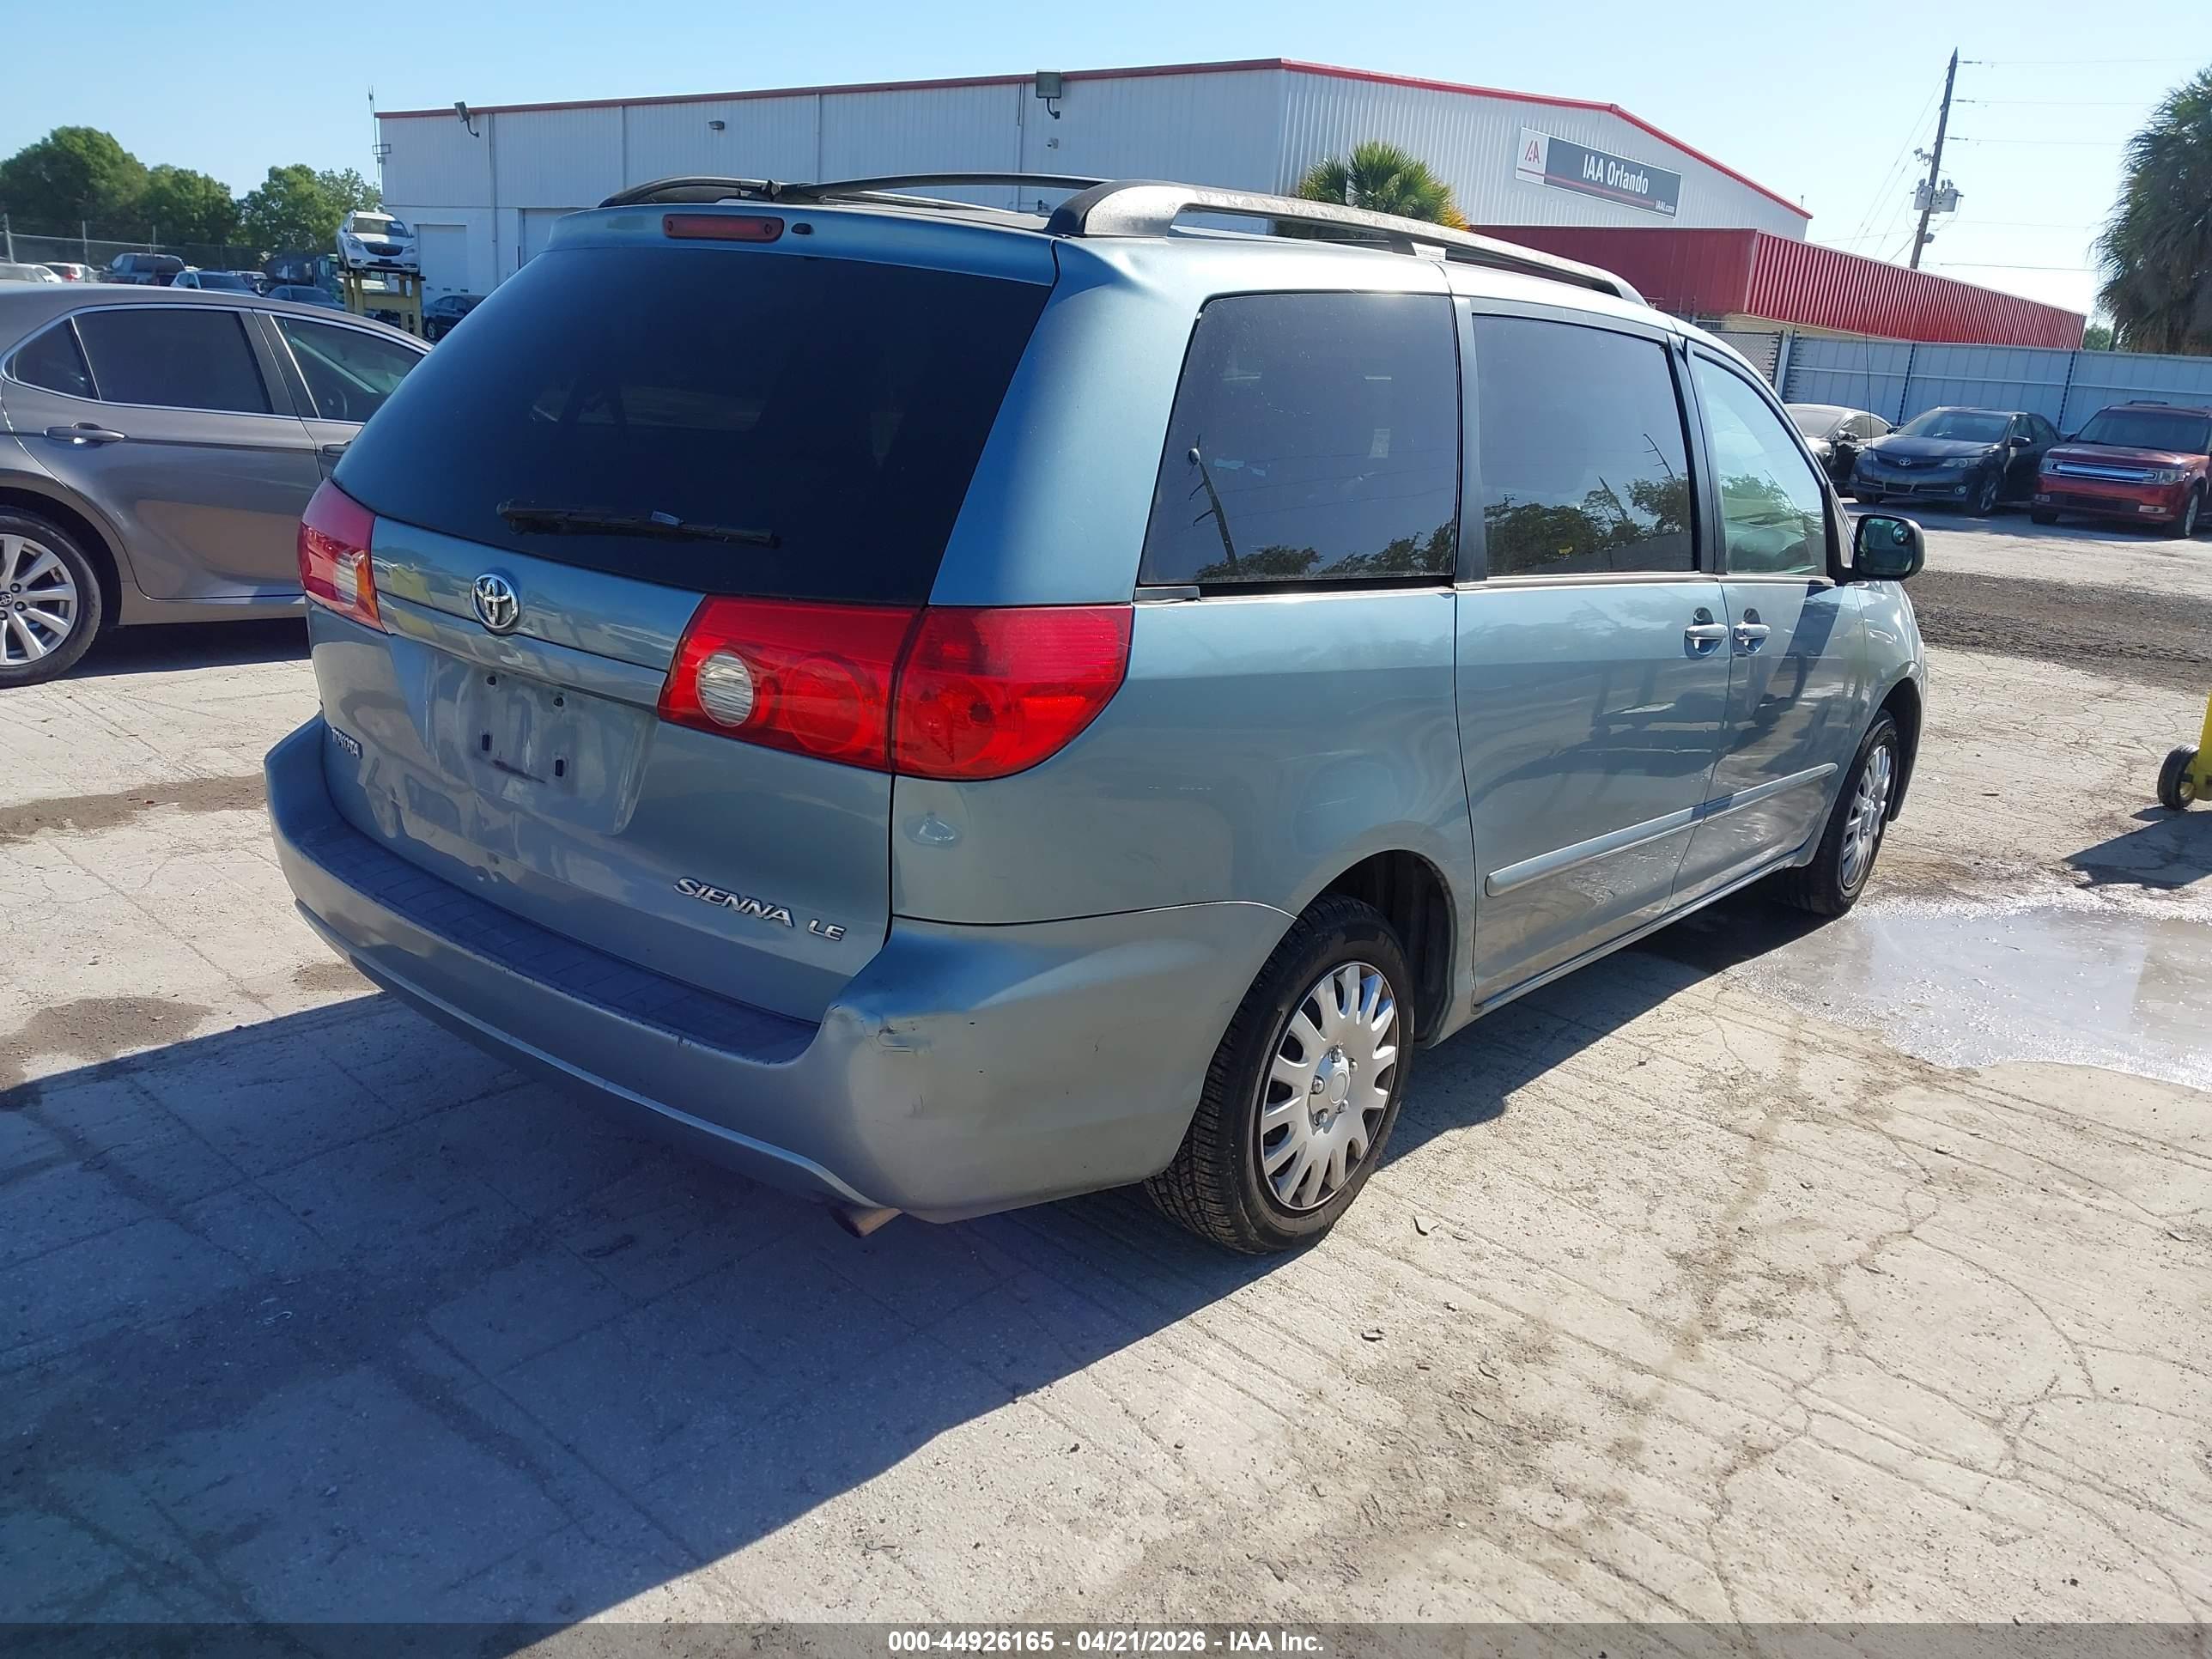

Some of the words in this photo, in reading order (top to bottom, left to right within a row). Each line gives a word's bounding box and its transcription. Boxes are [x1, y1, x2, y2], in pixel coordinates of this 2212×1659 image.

[1583, 154, 1605, 183] IAA
[1607, 161, 1650, 195] Orlando
[673, 878, 795, 927] SIENNA
[808, 920, 847, 941] LE
